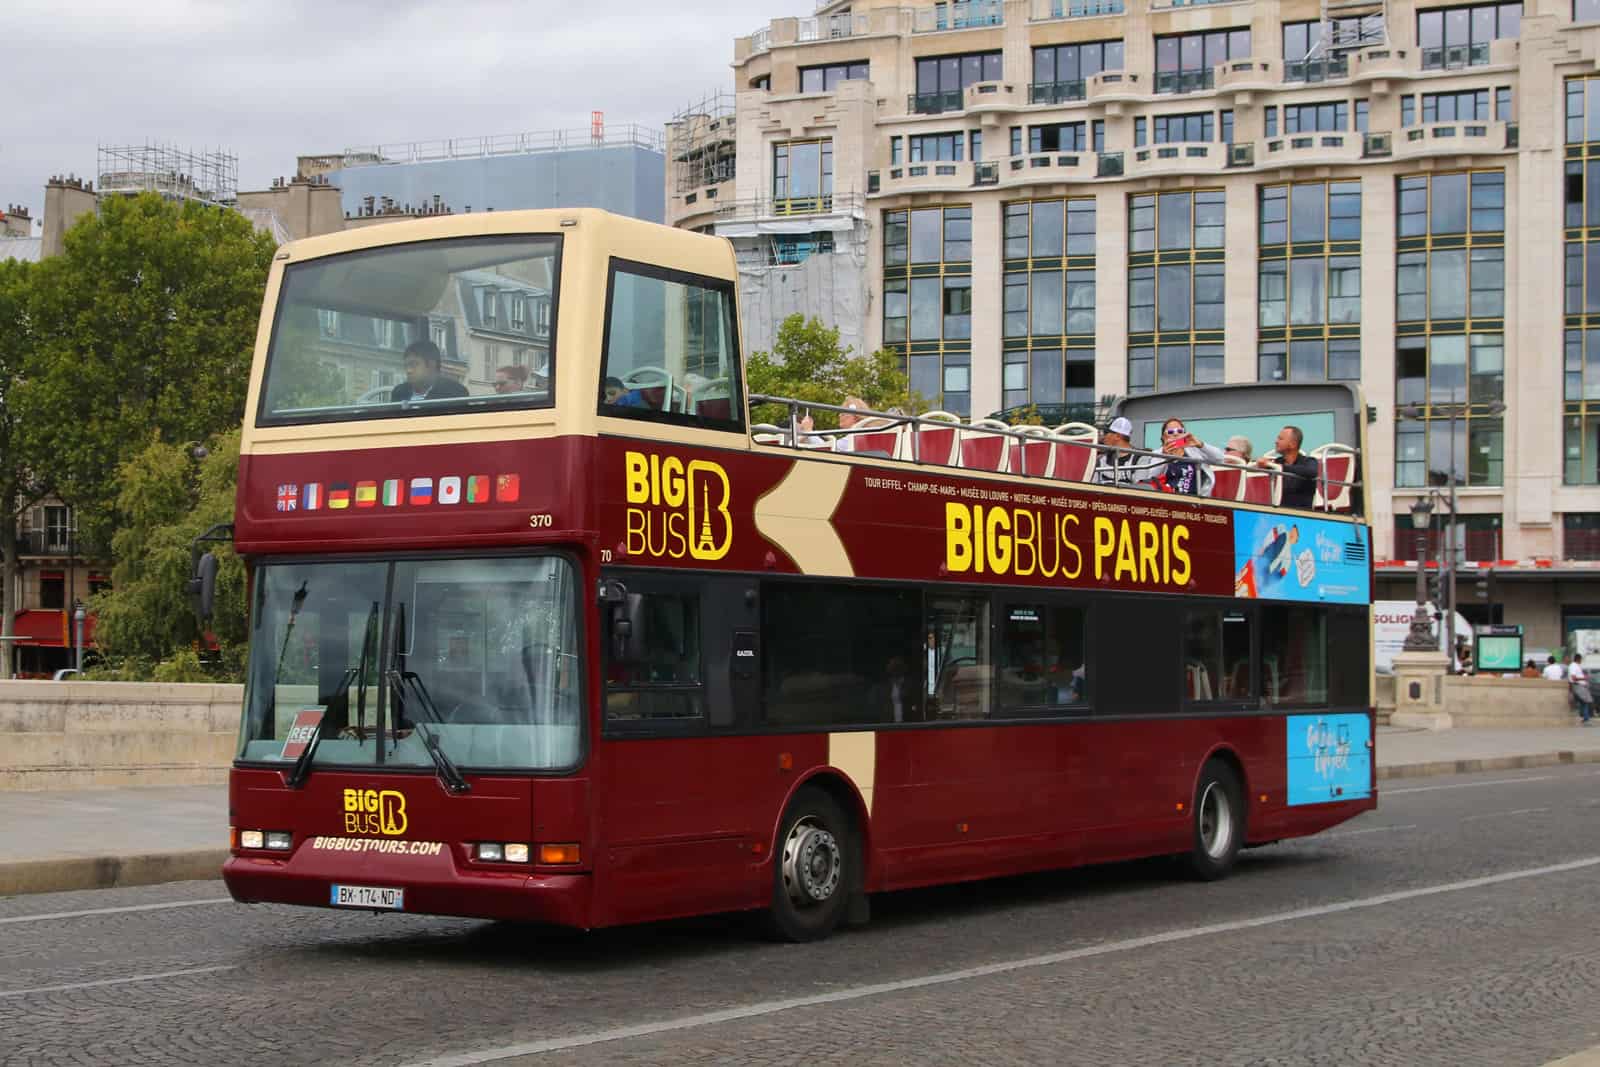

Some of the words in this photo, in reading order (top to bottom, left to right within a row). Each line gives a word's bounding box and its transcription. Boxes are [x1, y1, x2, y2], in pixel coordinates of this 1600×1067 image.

[625, 451, 686, 508] BIG
[864, 477, 881, 489] TOUR
[882, 478, 903, 490] EIFFEL
[530, 514, 553, 528] 370
[626, 508, 687, 559] BUS
[601, 549, 612, 562] 70
[1093, 516, 1192, 586] PARIS
[344, 788, 379, 813] BIG
[345, 812, 381, 834] BUS
